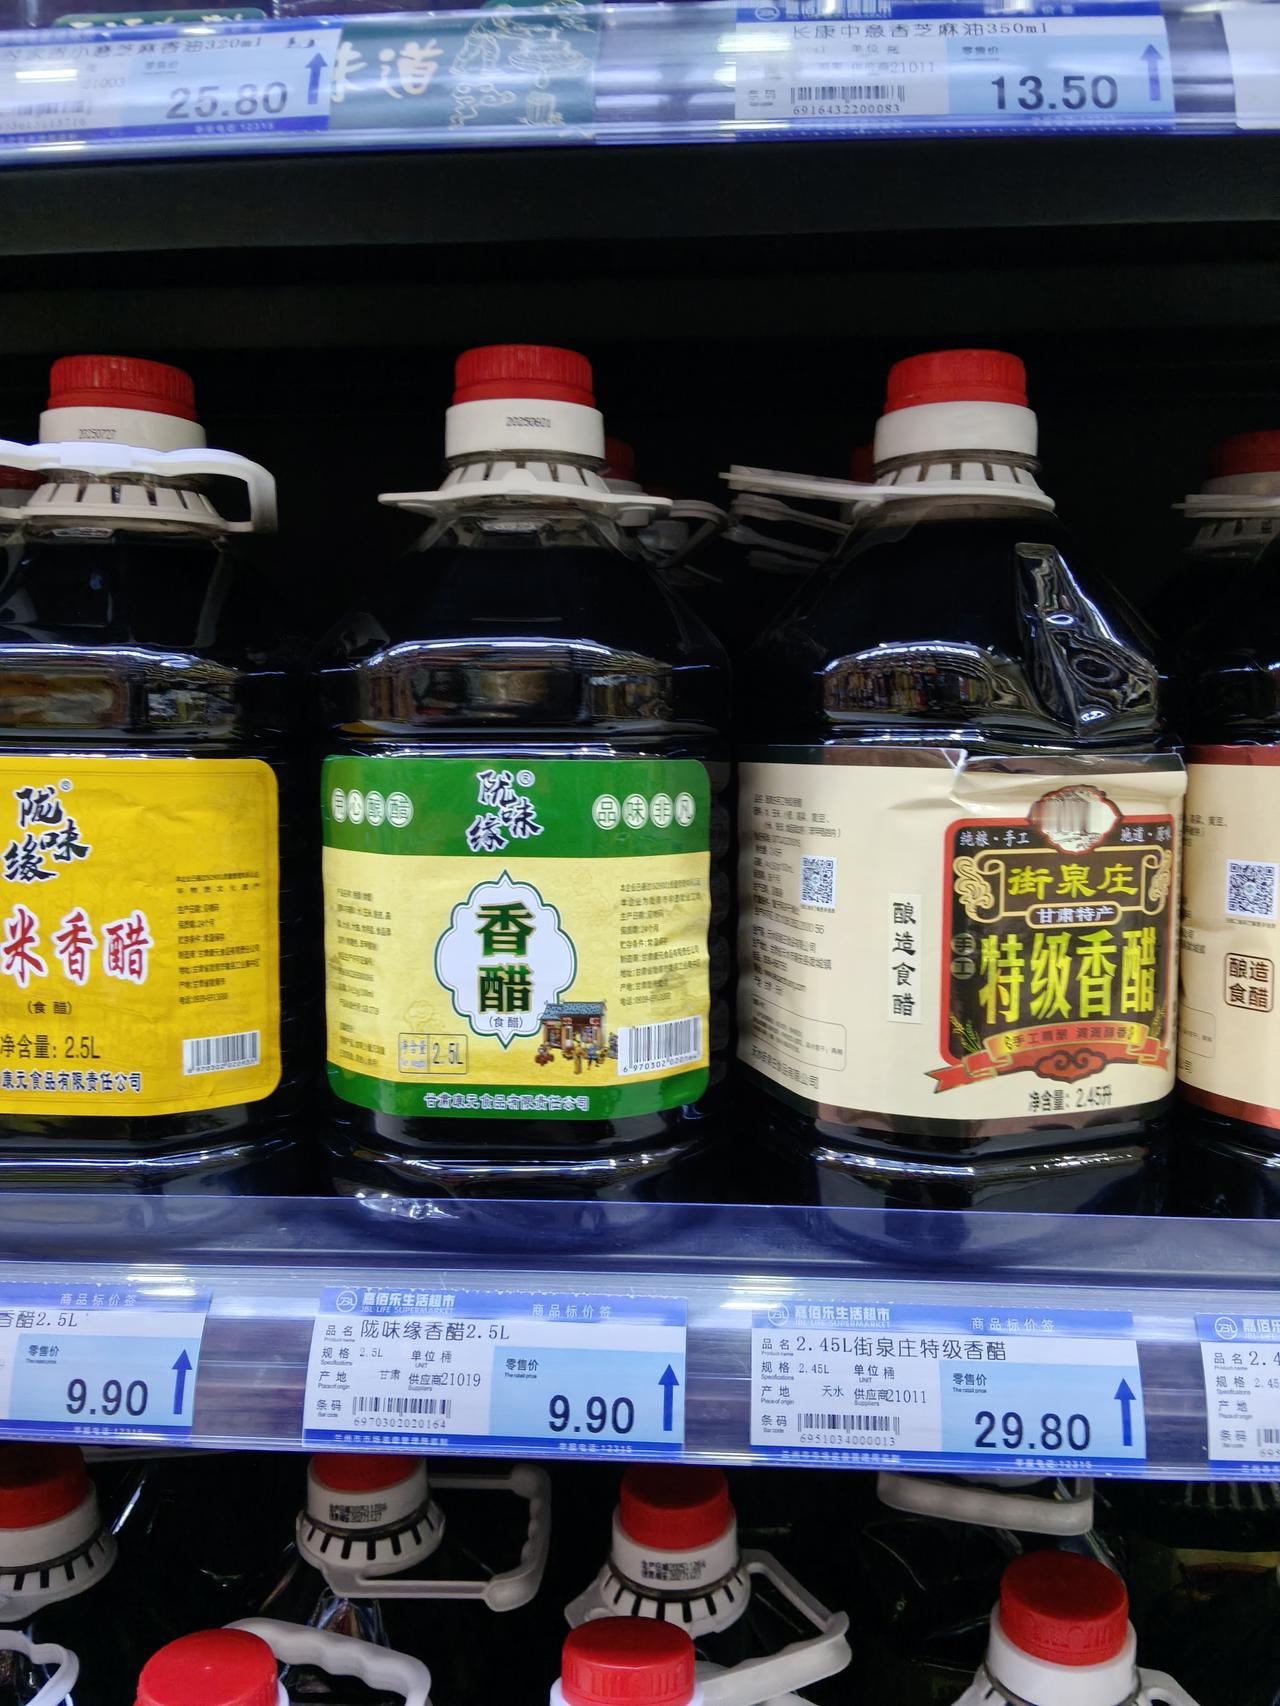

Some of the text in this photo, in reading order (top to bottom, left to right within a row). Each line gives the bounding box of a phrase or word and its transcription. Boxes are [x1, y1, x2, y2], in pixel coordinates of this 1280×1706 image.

[165, 82, 288, 119] 25.80
[991, 75, 1118, 110] 13.50
[793, 104, 900, 116] 6916432200083
[1008, 863, 1139, 901] 街泉庄
[1036, 906, 1115, 924] 甘肃特产
[4, 908, 150, 984] 米香醋
[476, 902, 536, 1013] 香醋
[892, 902, 917, 1017] 酿造食醋
[978, 926, 1157, 1025] 特级香醋
[1229, 957, 1269, 983] 酿造
[1229, 983, 1268, 1009] 食醋
[424, 1092, 589, 1112] 甘肃康元食品有限责任公司
[60, 1293, 137, 1307] 商品标价签
[362, 1292, 455, 1308] 嘉佰乐生活超市
[532, 1304, 611, 1318] 商品标价签
[795, 1305, 890, 1321] 嘉佰乐生活超市
[325, 1319, 510, 1341] 品名 陇味缘香醋2.5L
[971, 1317, 1055, 1332] 商品标价签
[28, 1345, 59, 1357] 零售价
[321, 1347, 350, 1359] 规格
[360, 1347, 383, 1358] 2.5L
[411, 1350, 435, 1362] 单位
[762, 1335, 1007, 1361] 品名 2.45L街泉庄特级香醋
[506, 1358, 539, 1372] 零售价
[1214, 1352, 1243, 1365] 品名
[319, 1371, 347, 1383] 产地
[761, 1361, 895, 1380] 规格 2.45L 单位 桶
[952, 1373, 987, 1386] 零售价
[1216, 1376, 1245, 1388] 规格
[66, 1378, 148, 1416] 9.90
[761, 1385, 790, 1398] 产地
[822, 1385, 844, 1398] 天水
[316, 1399, 342, 1412] 条码
[1218, 1400, 1248, 1413] 产地
[549, 1394, 635, 1434] 9.90
[761, 1414, 787, 1427] 条码
[353, 1416, 446, 1429] 6970302020164
[975, 1410, 1091, 1451] 29.80
[800, 1432, 896, 1446] 6951034000013
[1220, 1429, 1247, 1442] 条码
